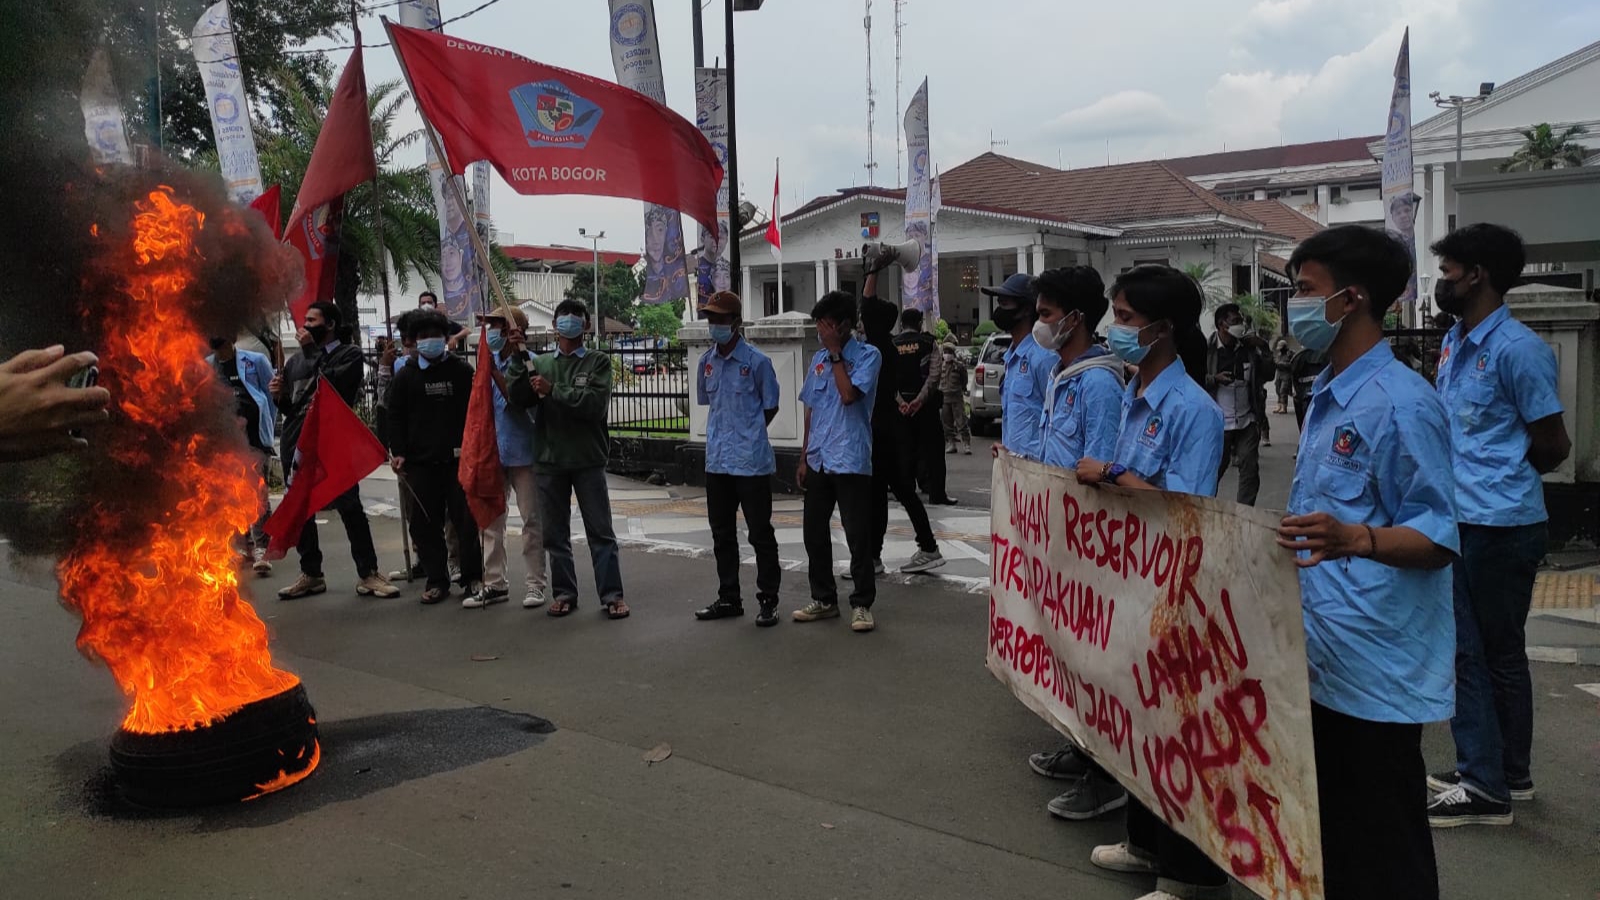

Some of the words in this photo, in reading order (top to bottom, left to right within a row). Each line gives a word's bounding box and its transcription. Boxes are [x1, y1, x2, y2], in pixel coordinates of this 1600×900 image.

[446, 38, 506, 58] DEWAN
[512, 166, 548, 181] KOTA
[551, 166, 607, 182] BOGOR
[1062, 491, 1207, 619] RESERVOIR
[1132, 588, 1249, 710] LAHAN
[1077, 673, 1138, 778] JADI
